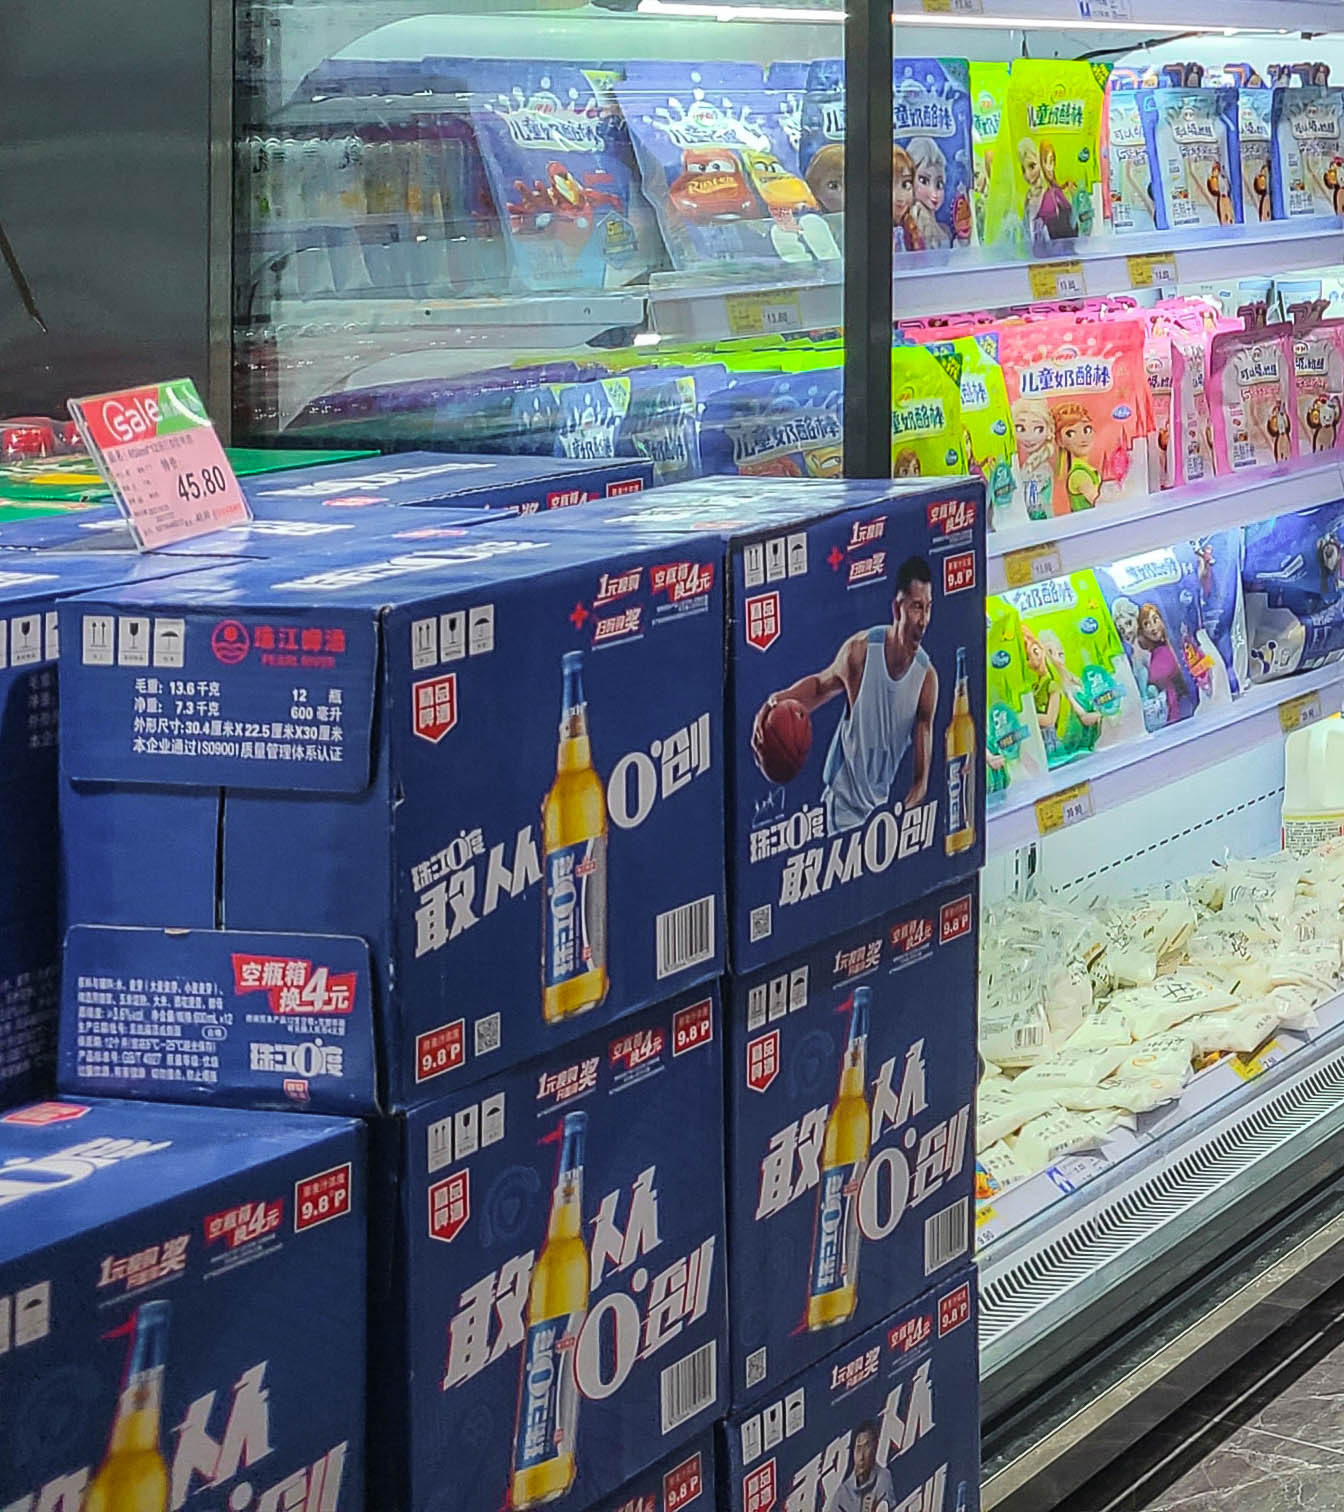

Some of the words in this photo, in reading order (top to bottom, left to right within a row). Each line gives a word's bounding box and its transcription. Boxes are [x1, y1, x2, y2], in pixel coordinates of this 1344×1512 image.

[1021, 364, 1111, 395] 儿童奶酪棒
[178, 465, 227, 502] 45.80
[169, 681, 195, 697] 13.6
[196, 681, 221, 698] 千克
[292, 688, 308, 704] 12
[175, 700, 195, 716] 7.3
[196, 701, 221, 717] 千克
[290, 706, 313, 721] 600
[240, 959, 307, 987] 空瓶箱
[279, 966, 350, 1013] 换4元
[756, 1103, 830, 1222] 敢
[442, 1248, 536, 1392] 敢
